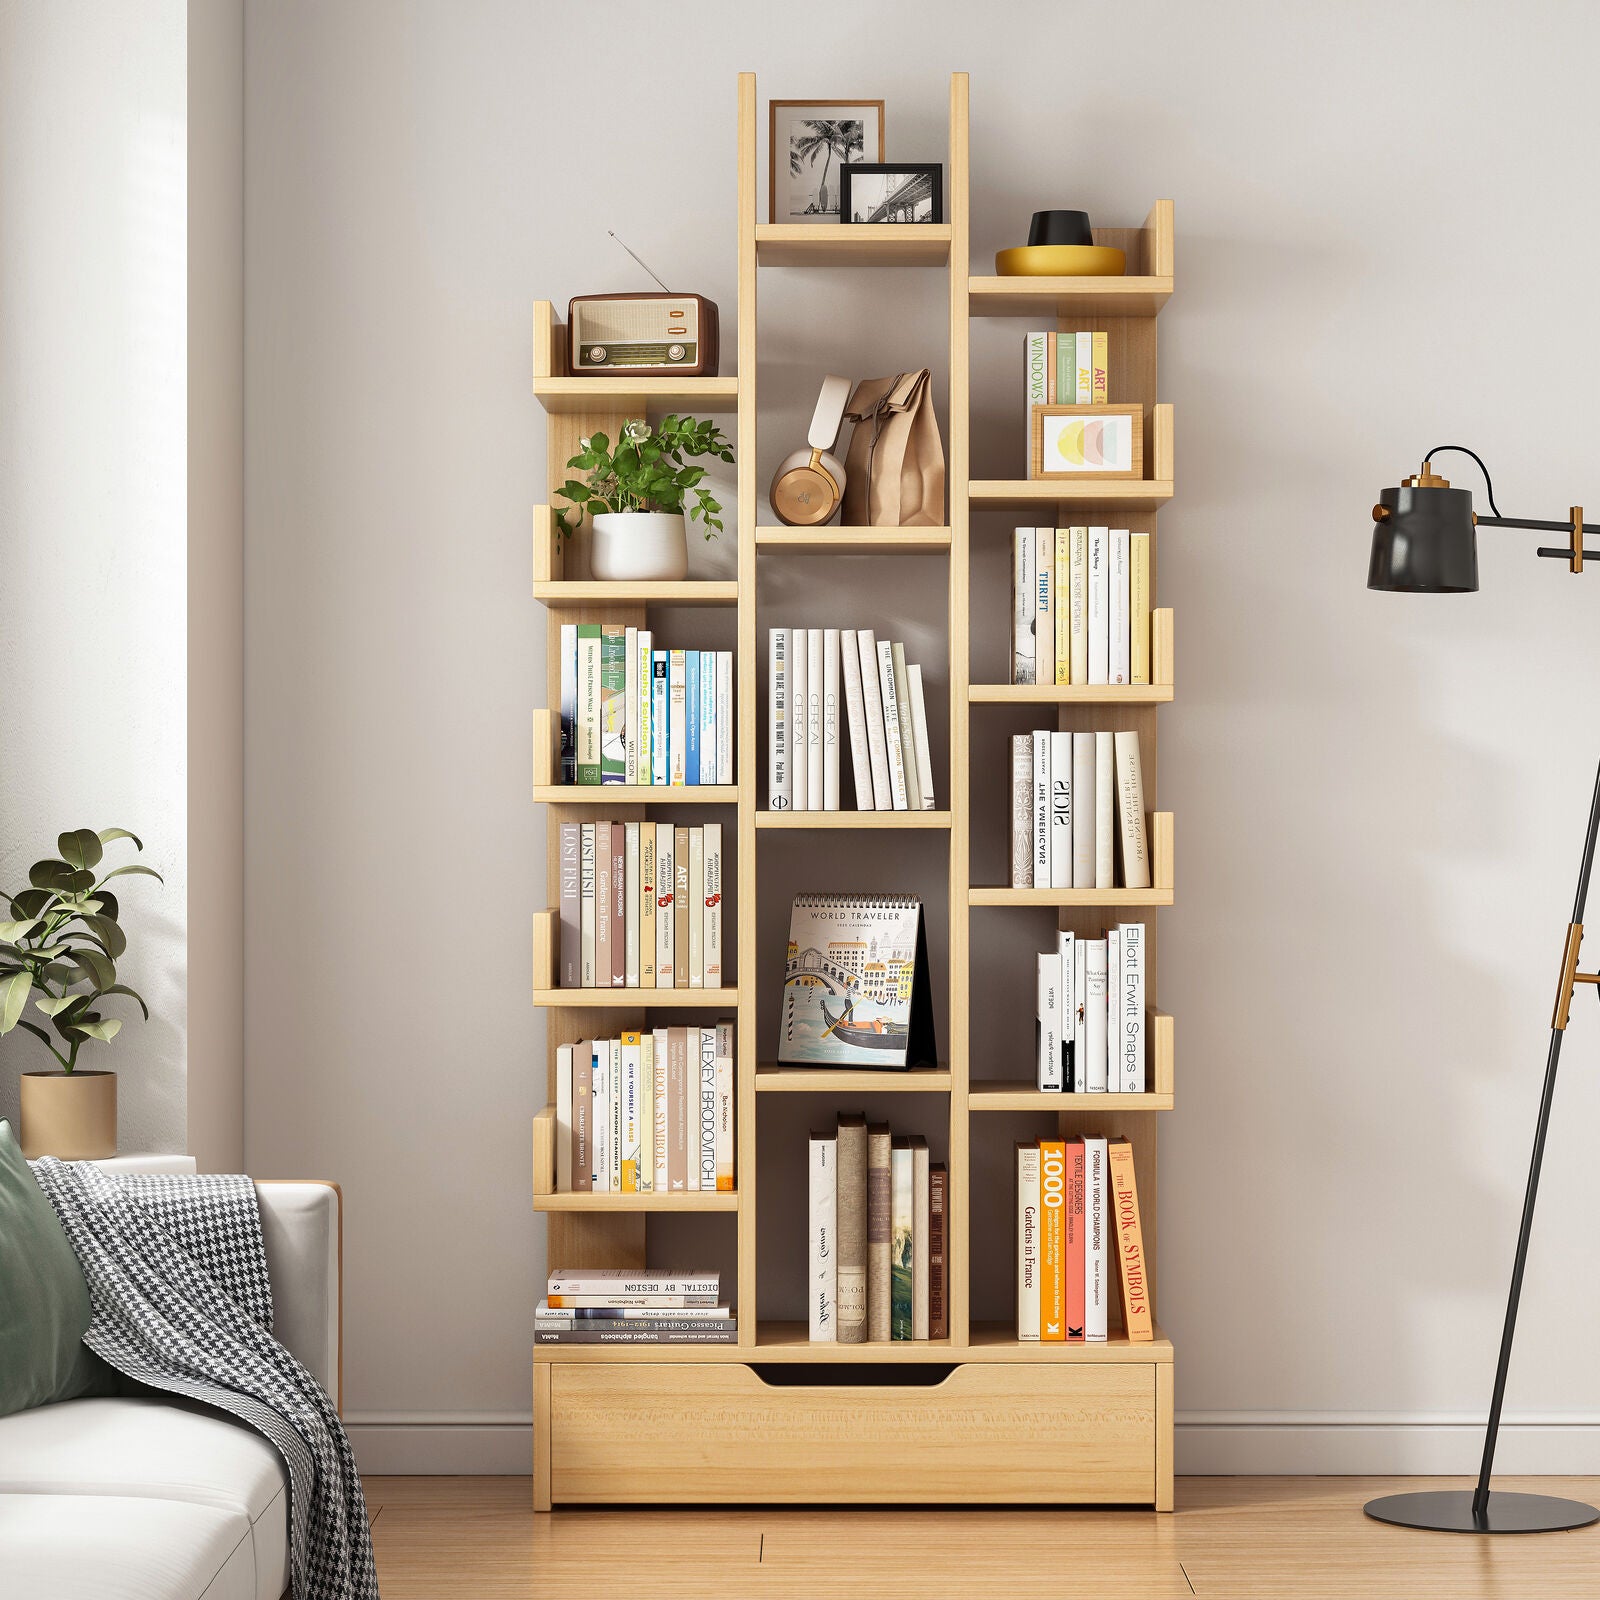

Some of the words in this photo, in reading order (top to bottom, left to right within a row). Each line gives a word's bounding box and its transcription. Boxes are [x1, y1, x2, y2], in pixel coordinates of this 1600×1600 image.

[1031, 337, 1043, 399] WINDOWS
[1079, 368, 1090, 392] ART
[1095, 368, 1106, 392] ART
[1040, 572, 1048, 612] THRIFT
[608, 630, 620, 644] The
[776, 642, 784, 650] NOT
[776, 673, 784, 681] YOU
[886, 664, 894, 700] UNCOMMON
[794, 693, 803, 752] CEREAL
[810, 693, 820, 752] CEREAL
[826, 693, 836, 752] CEREAL
[892, 726, 899, 734] OF
[776, 731, 784, 742] WANT
[776, 762, 784, 770] Paul
[893, 739, 902, 766] COMMON
[897, 770, 905, 802] OBJECTS
[564, 828, 577, 864] LOST
[583, 829, 594, 864] LOST
[564, 868, 577, 898] FISH
[583, 869, 594, 898] FISH
[600, 871, 608, 904] Gardens
[677, 865, 687, 891] ART
[600, 905, 608, 913] in
[810, 912, 846, 920] WORLD
[600, 915, 608, 942] France
[1126, 928, 1139, 968] Elliott
[1126, 974, 1139, 1016] Erwitt
[702, 1032, 714, 1087] ALEXEY
[1124, 1022, 1139, 1072] Snaps
[655, 1068, 665, 1100] BOOK
[655, 1112, 665, 1169] SYMBOLS
[702, 1090, 714, 1180] BRODOVITCH
[1043, 1149, 1064, 1207] 1000
[1074, 1154, 1083, 1178] TEXTILE
[931, 1175, 943, 1186] J.K.
[1116, 1174, 1124, 1188] THE
[931, 1187, 943, 1212] ROWLING
[1074, 1180, 1083, 1214] DESIGNERS
[1118, 1191, 1136, 1230] BOOK
[931, 1214, 942, 1232] HARRY
[1024, 1206, 1036, 1244] Gardens
[931, 1234, 942, 1254] POTTER
[1024, 1246, 1036, 1255] in
[1122, 1233, 1131, 1242] OF
[931, 1264, 942, 1291] CHAMBER
[1024, 1257, 1036, 1288] France
[1124, 1245, 1146, 1314] SYMBOLS
[624, 1284, 659, 1292] DESIGN
[664, 1284, 675, 1292] BY
[681, 1284, 718, 1292] DIGITAL
[931, 1296, 942, 1320] SECRETS
[654, 1322, 689, 1330] Guitars
[691, 1322, 724, 1330] Picasso
